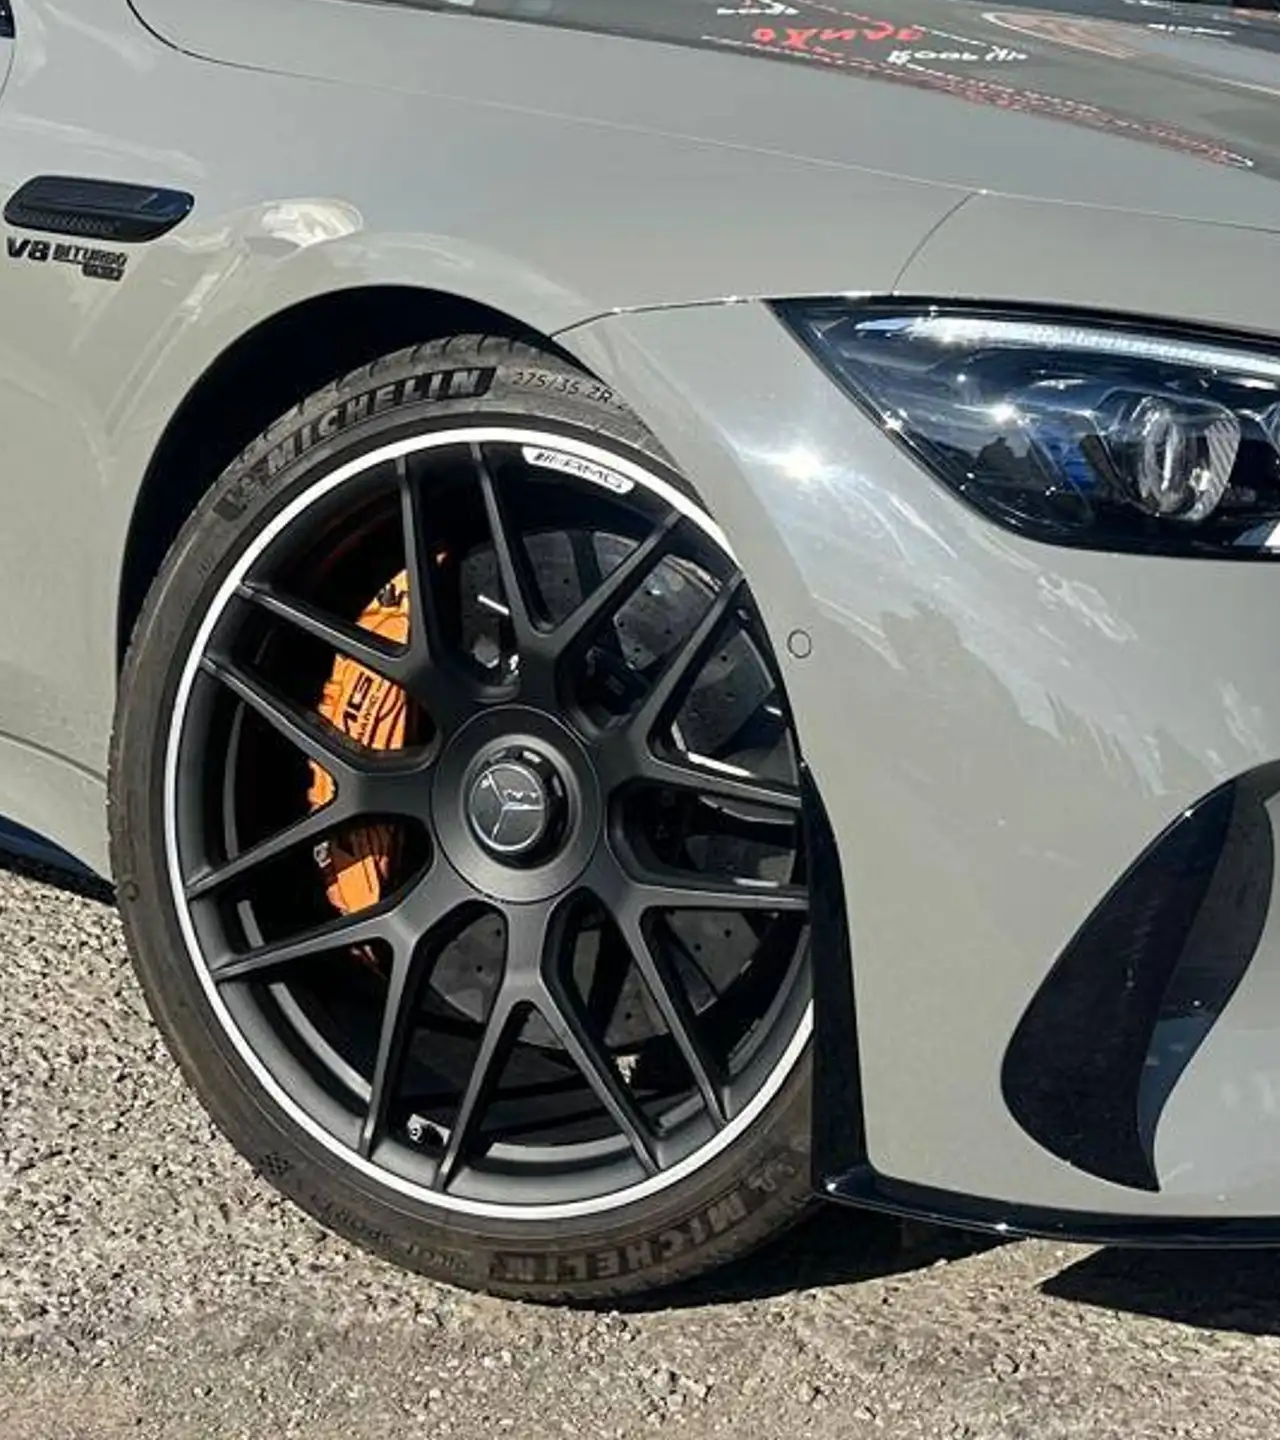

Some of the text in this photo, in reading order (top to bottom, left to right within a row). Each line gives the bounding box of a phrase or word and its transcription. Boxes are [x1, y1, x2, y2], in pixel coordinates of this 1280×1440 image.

[6, 236, 51, 262] V8
[267, 367, 484, 474] MICHELIN
[504, 1192, 749, 1283] MICHELIN
